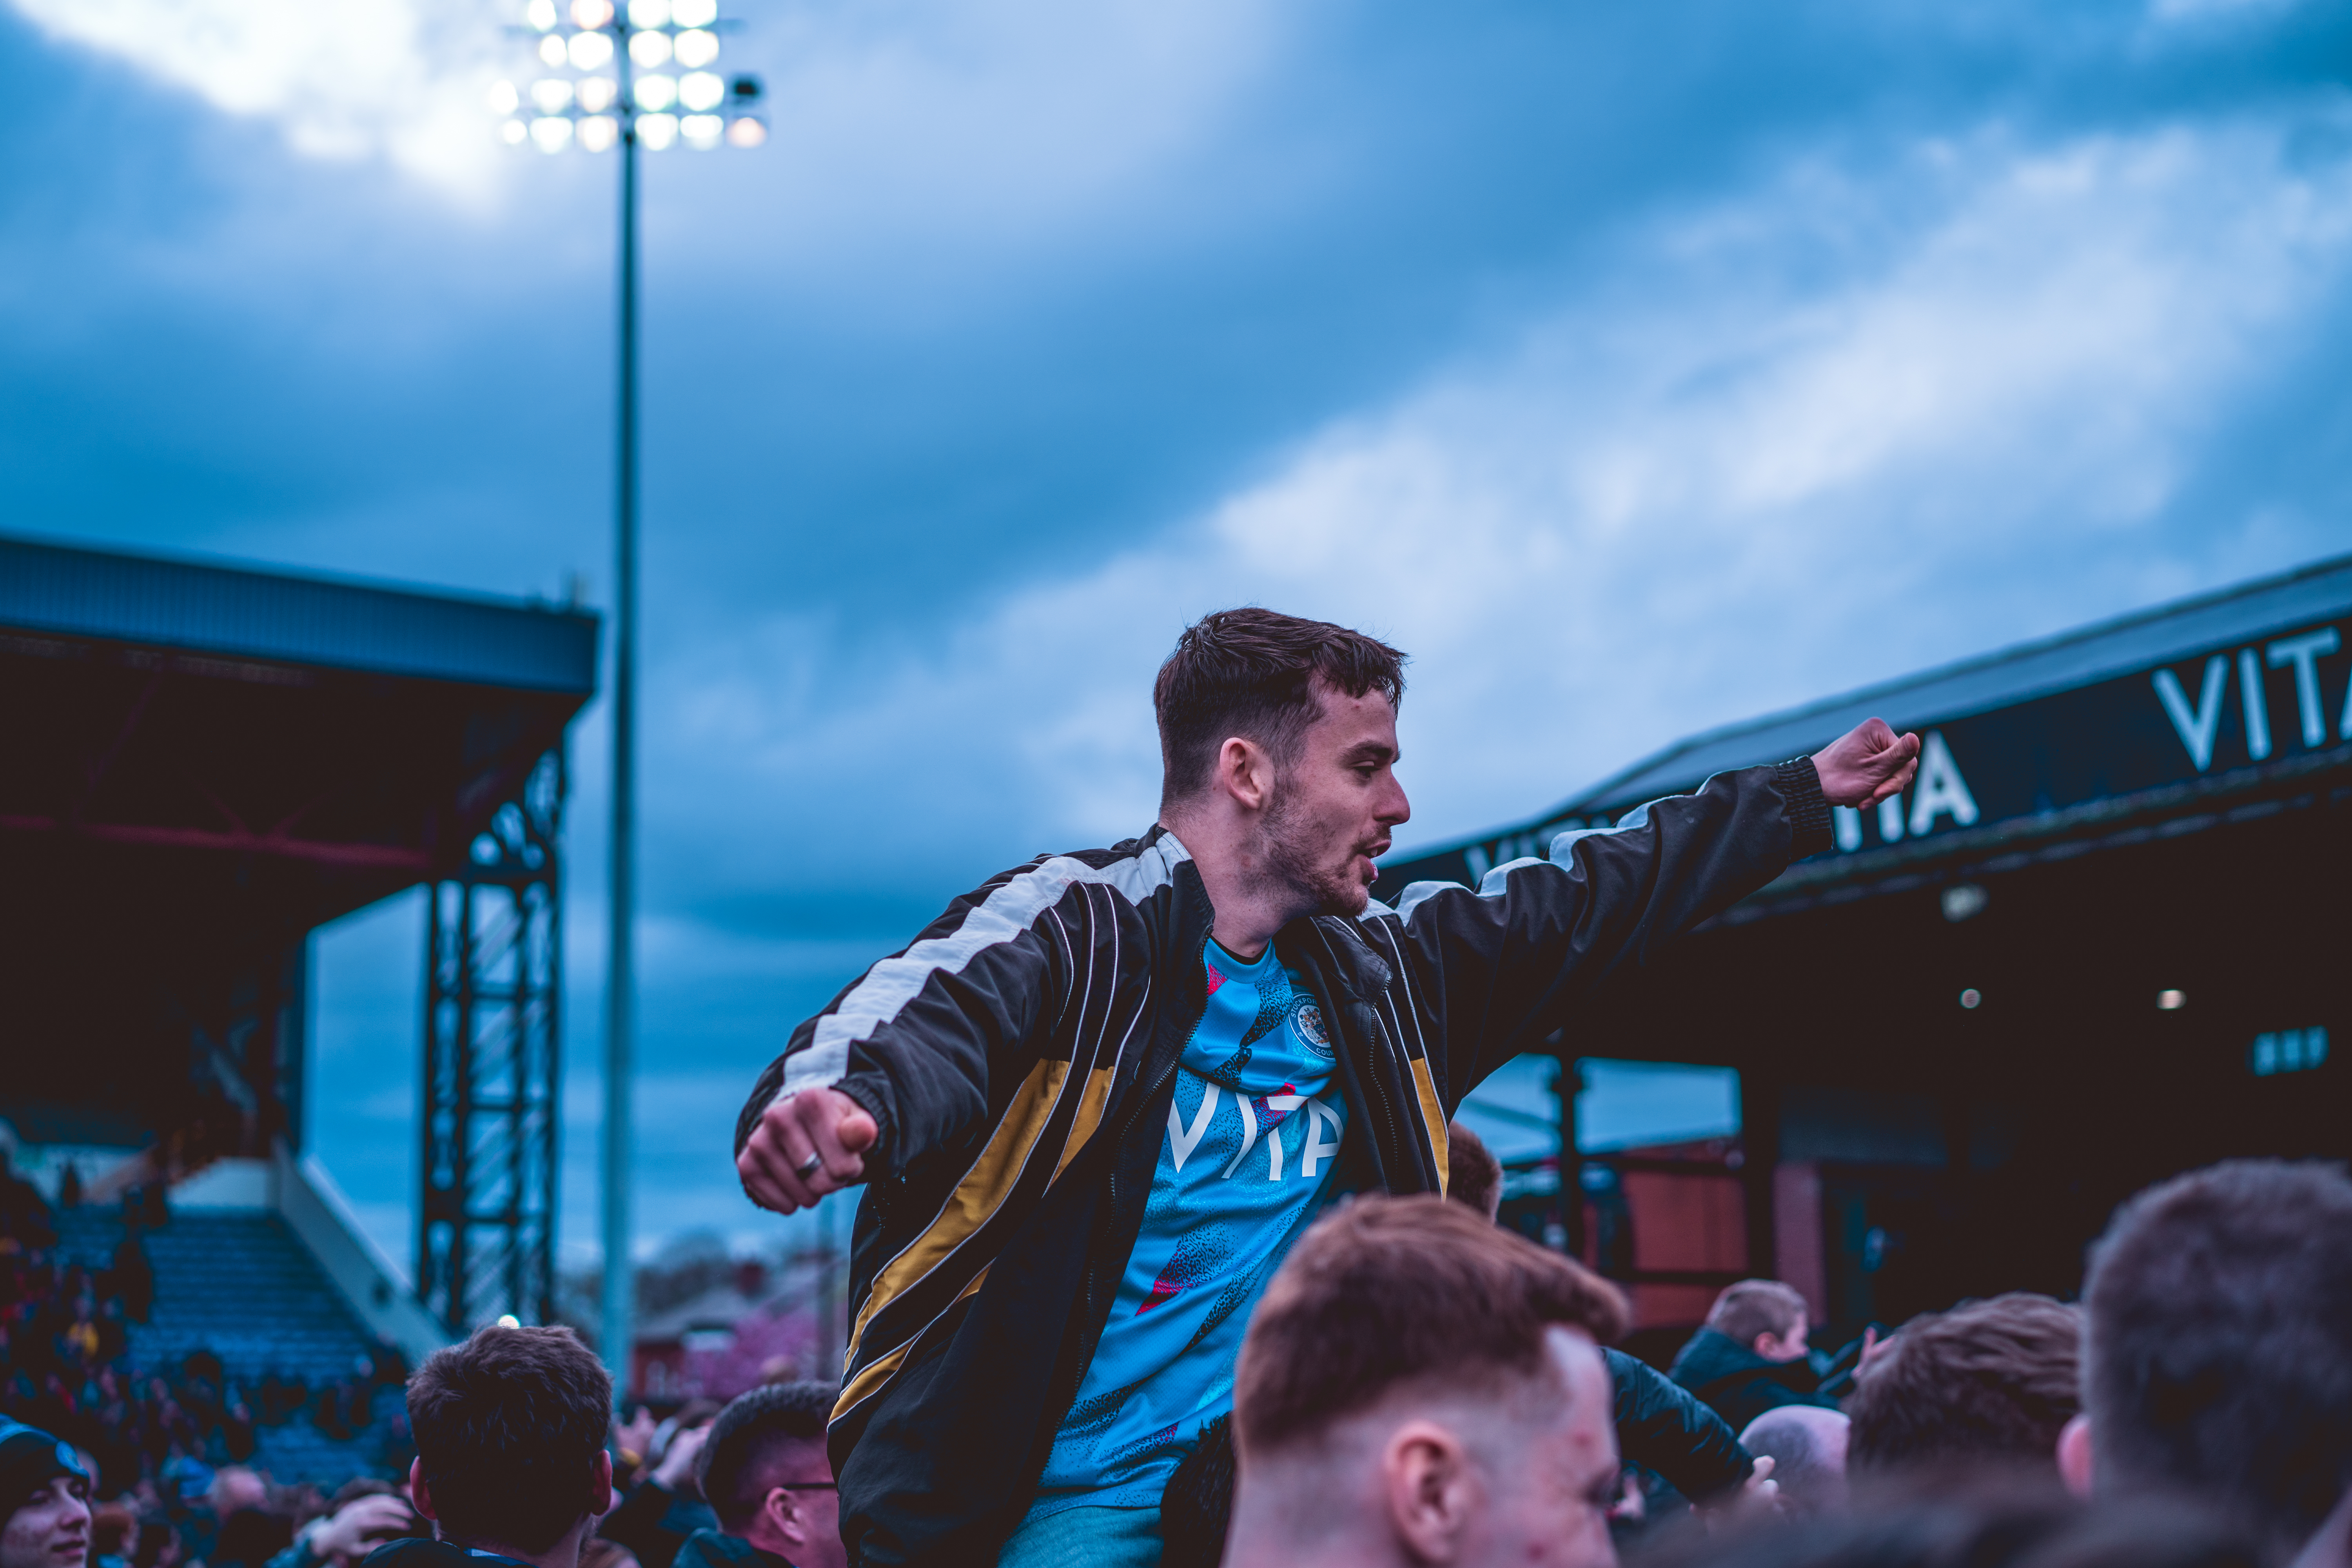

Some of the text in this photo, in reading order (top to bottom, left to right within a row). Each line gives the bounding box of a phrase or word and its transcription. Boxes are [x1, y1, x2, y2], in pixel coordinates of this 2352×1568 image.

[2151, 627, 2352, 772] VIT
[1291, 998, 1317, 1018] STOCKPOR
[1167, 1082, 1344, 1181] VITA
